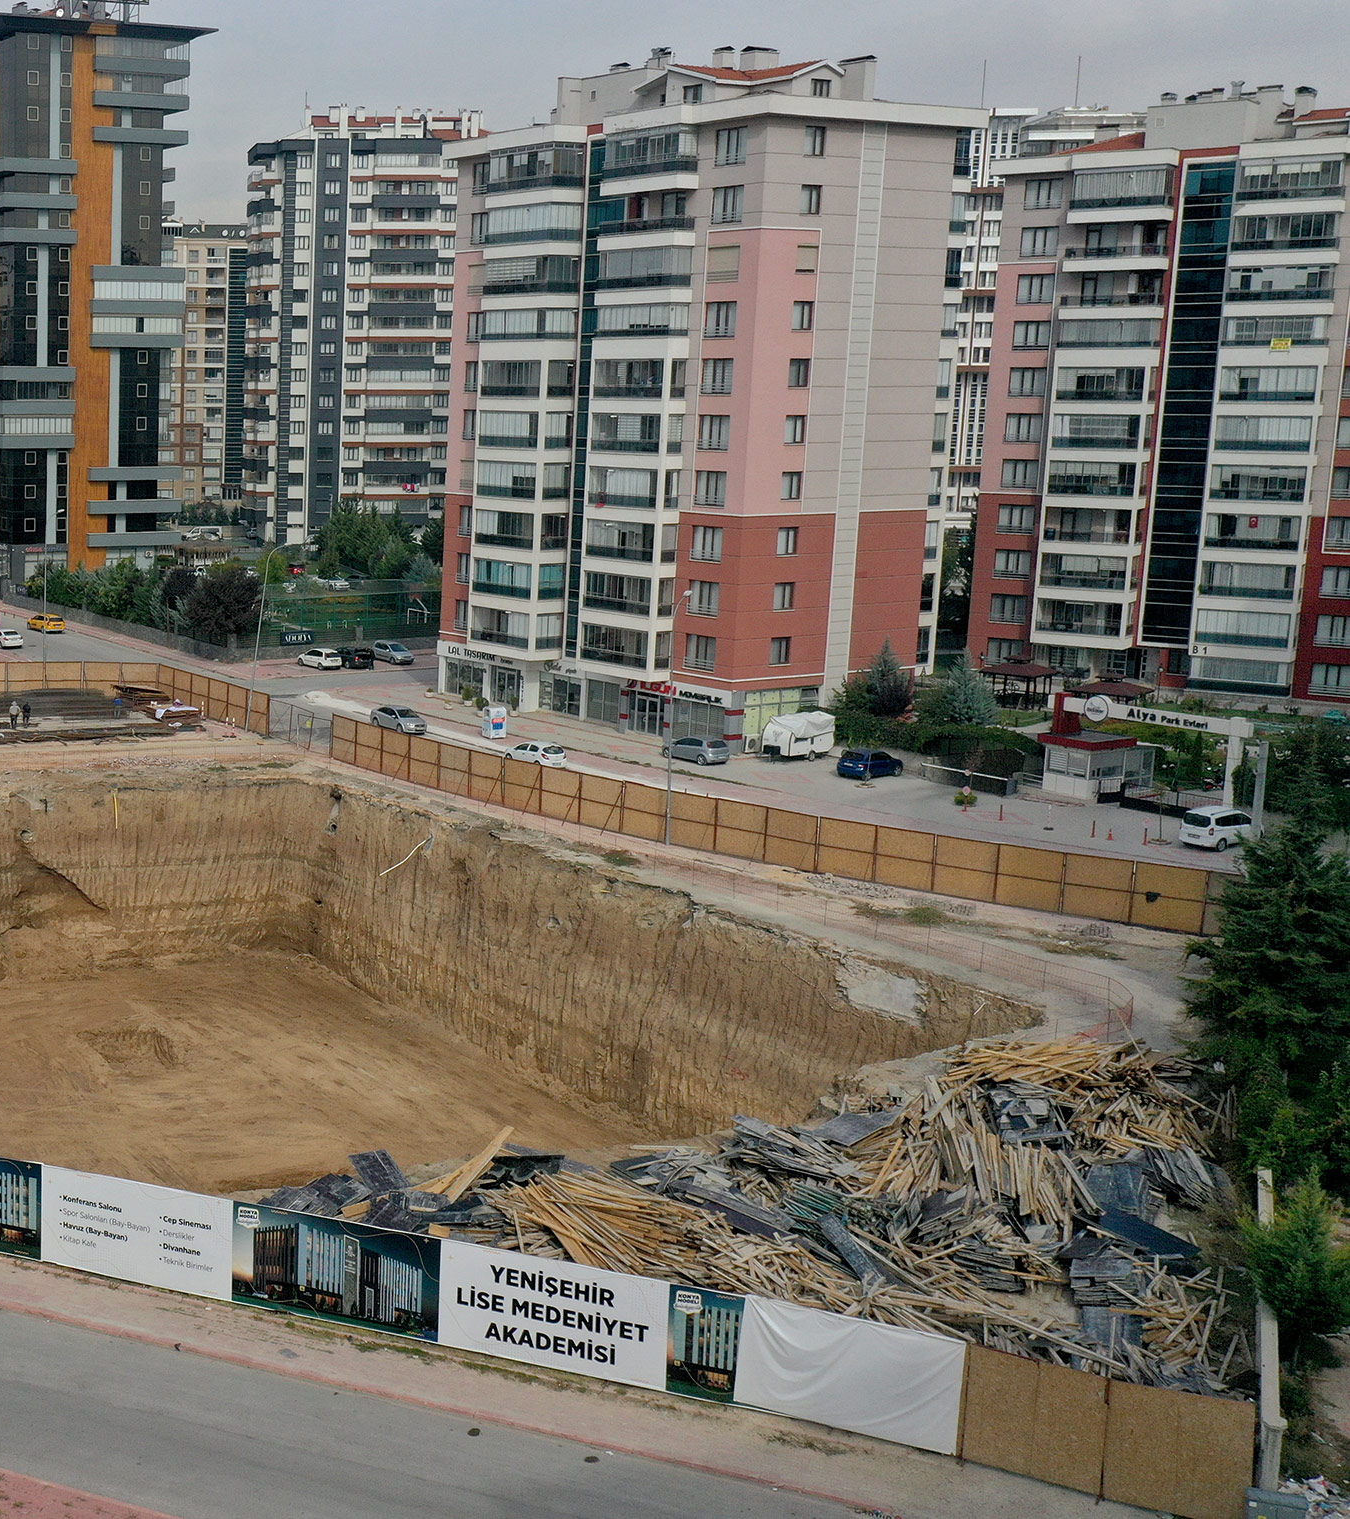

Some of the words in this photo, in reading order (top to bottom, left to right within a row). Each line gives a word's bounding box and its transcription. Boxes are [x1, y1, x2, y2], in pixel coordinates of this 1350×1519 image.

[1127, 708, 1156, 722] Alya
[1161, 715, 1181, 726] Park
[1183, 719, 1209, 730] Evleri
[62, 1194, 97, 1208] Konferans
[98, 1202, 122, 1213] Salonu
[62, 1208, 79, 1218] Spor
[79, 1211, 108, 1224] Salonları
[109, 1218, 151, 1234] (Bay-Bayan)
[163, 1215, 177, 1226] Cep
[178, 1219, 212, 1231] Sineması
[62, 1221, 84, 1233] Havuz
[85, 1226, 128, 1242] (Bay-Bayan)
[62, 1235, 80, 1246] Kitap
[81, 1239, 97, 1248] Kafe
[163, 1229, 195, 1241] Derslikler
[163, 1242, 201, 1256] Divanhane
[163, 1256, 184, 1267] Teknik
[186, 1261, 213, 1272] Birimler
[489, 1264, 615, 1308] YENİŞEHİR
[456, 1285, 505, 1314] LİSE
[511, 1298, 649, 1343] MEDENİYET
[484, 1322, 616, 1365] AKADEMİSİ
